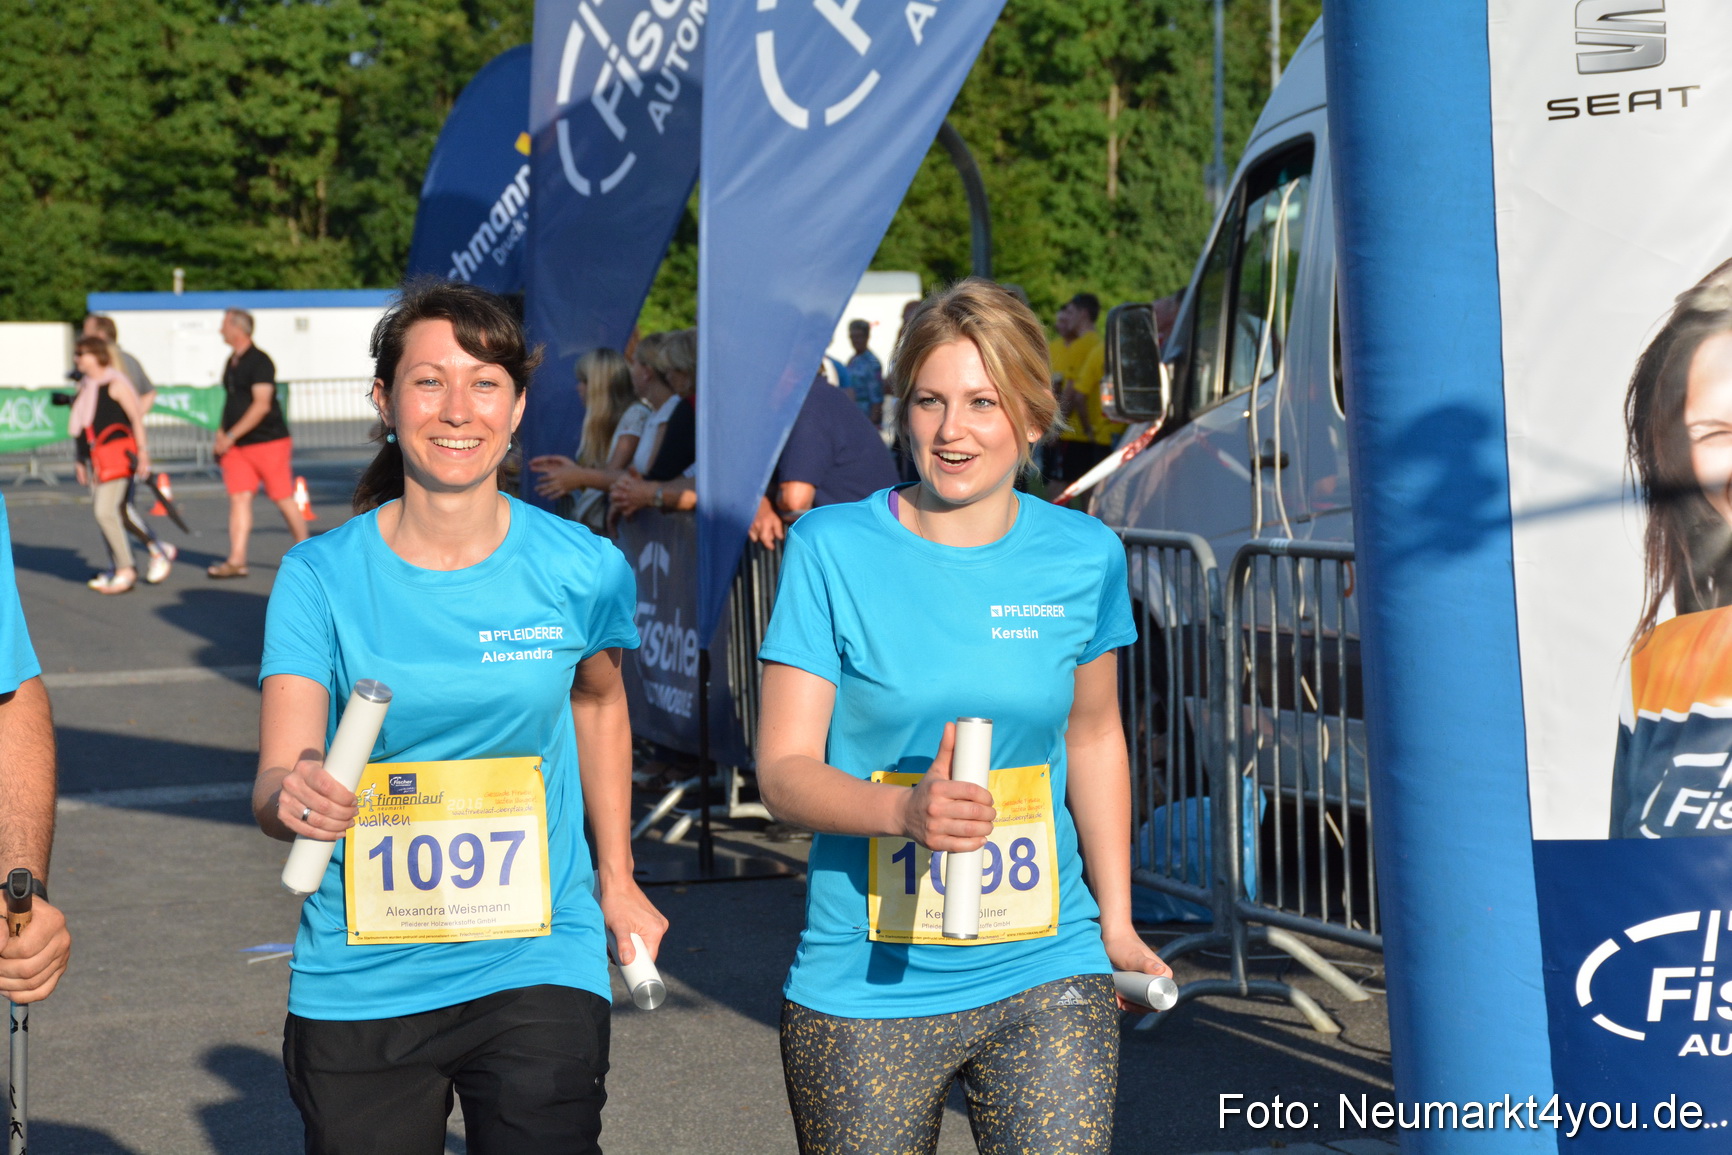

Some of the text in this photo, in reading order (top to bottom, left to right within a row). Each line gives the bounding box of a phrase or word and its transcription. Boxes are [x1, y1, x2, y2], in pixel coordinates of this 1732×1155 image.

[1546, 85, 1700, 121] SEAT
[1004, 605, 1066, 617] PFLEIDERER
[493, 626, 564, 641] PFLEIDERER
[991, 627, 1039, 639] Kerstin
[481, 647, 553, 663] Alexandra
[377, 791, 445, 806] firmenlauf
[447, 798, 483, 811] 2016
[359, 812, 411, 827] walken
[369, 830, 526, 891] 1097
[386, 902, 511, 917] Alexandra Weismann
[978, 907, 1007, 920] öllner
[400, 916, 497, 928] Pfleiderer Holzwerkstoffe GmbH
